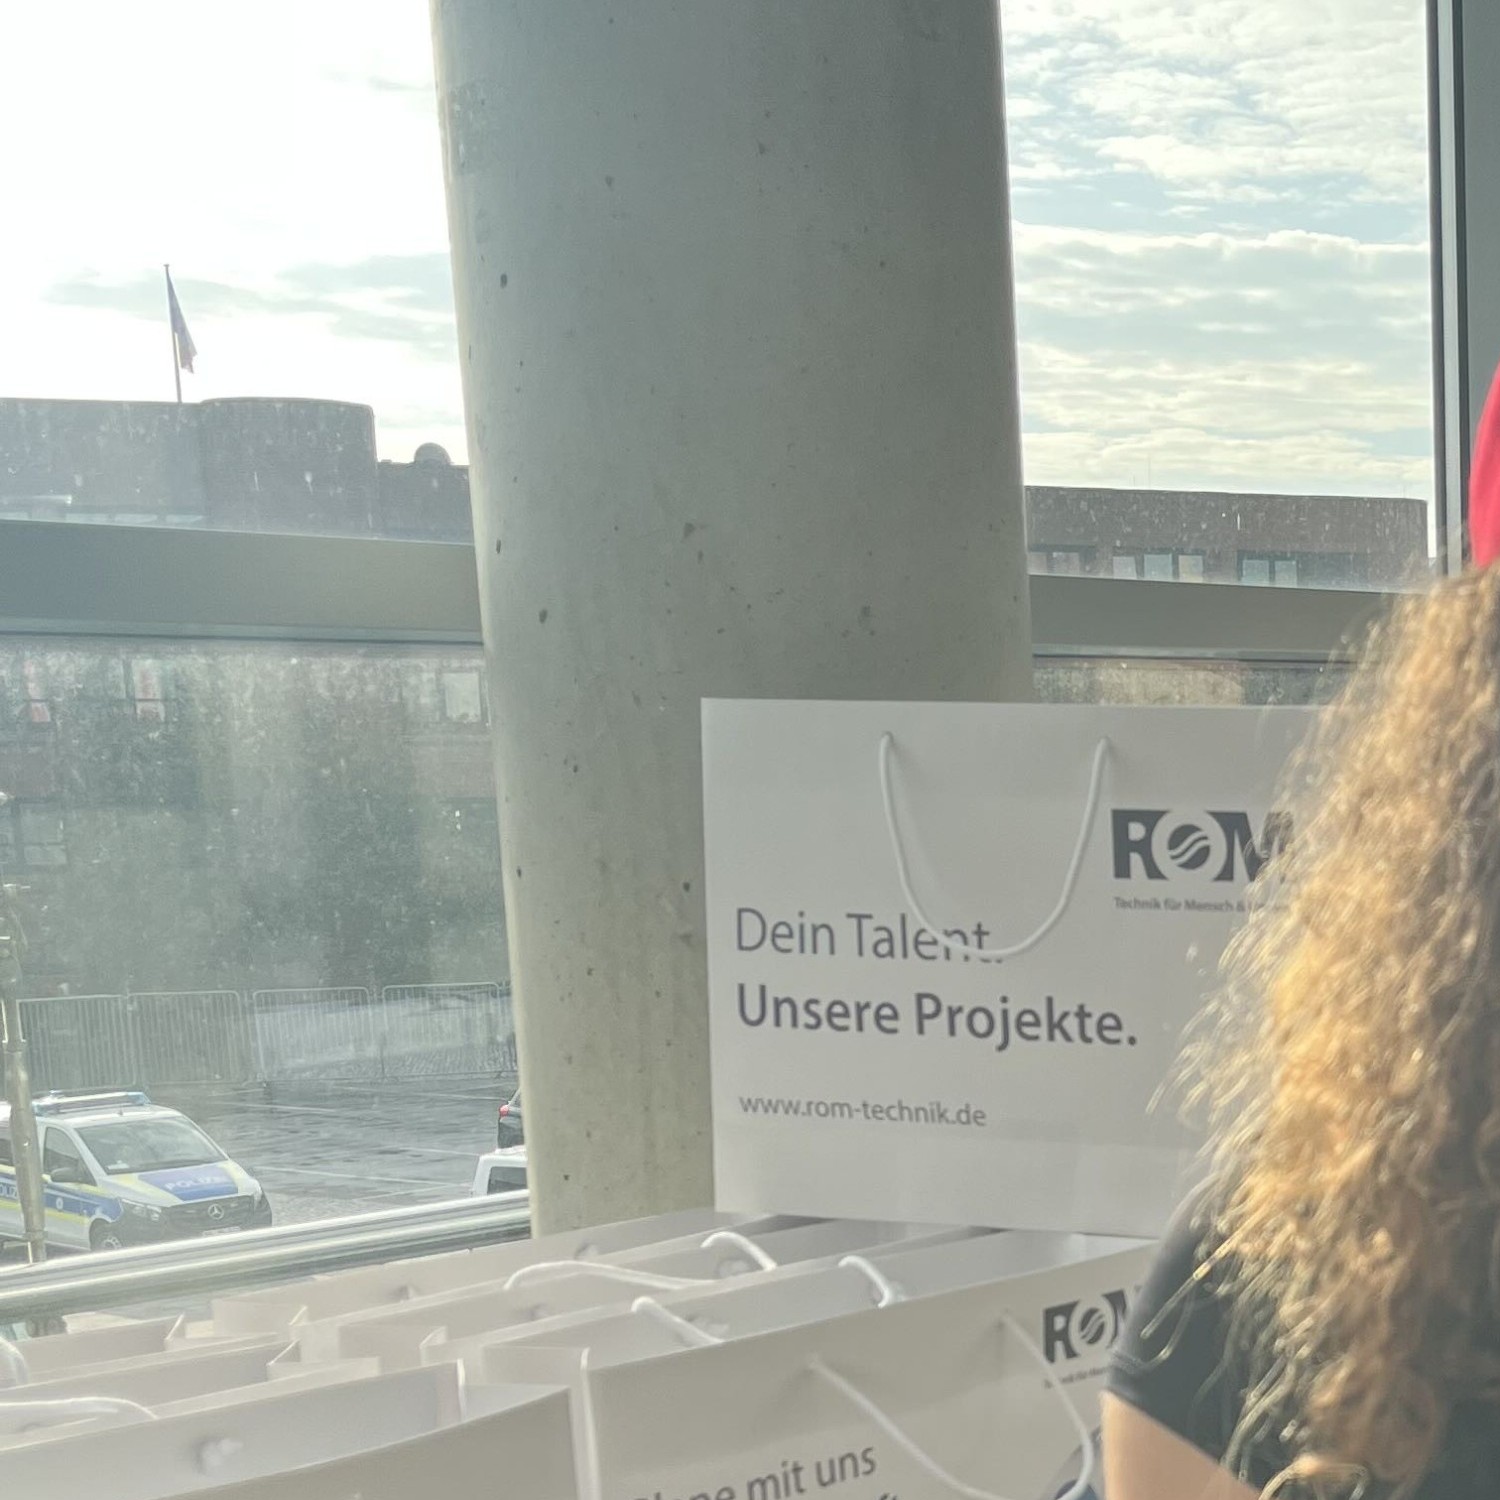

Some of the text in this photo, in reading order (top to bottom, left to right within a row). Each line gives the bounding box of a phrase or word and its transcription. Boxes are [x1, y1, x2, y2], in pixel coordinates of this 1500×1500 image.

[736, 907, 836, 956] Dein
[736, 983, 1138, 1052] Unsere Projekte.
[739, 1095, 987, 1127] www.rom-technik.de
[815, 1447, 877, 1488] uns
